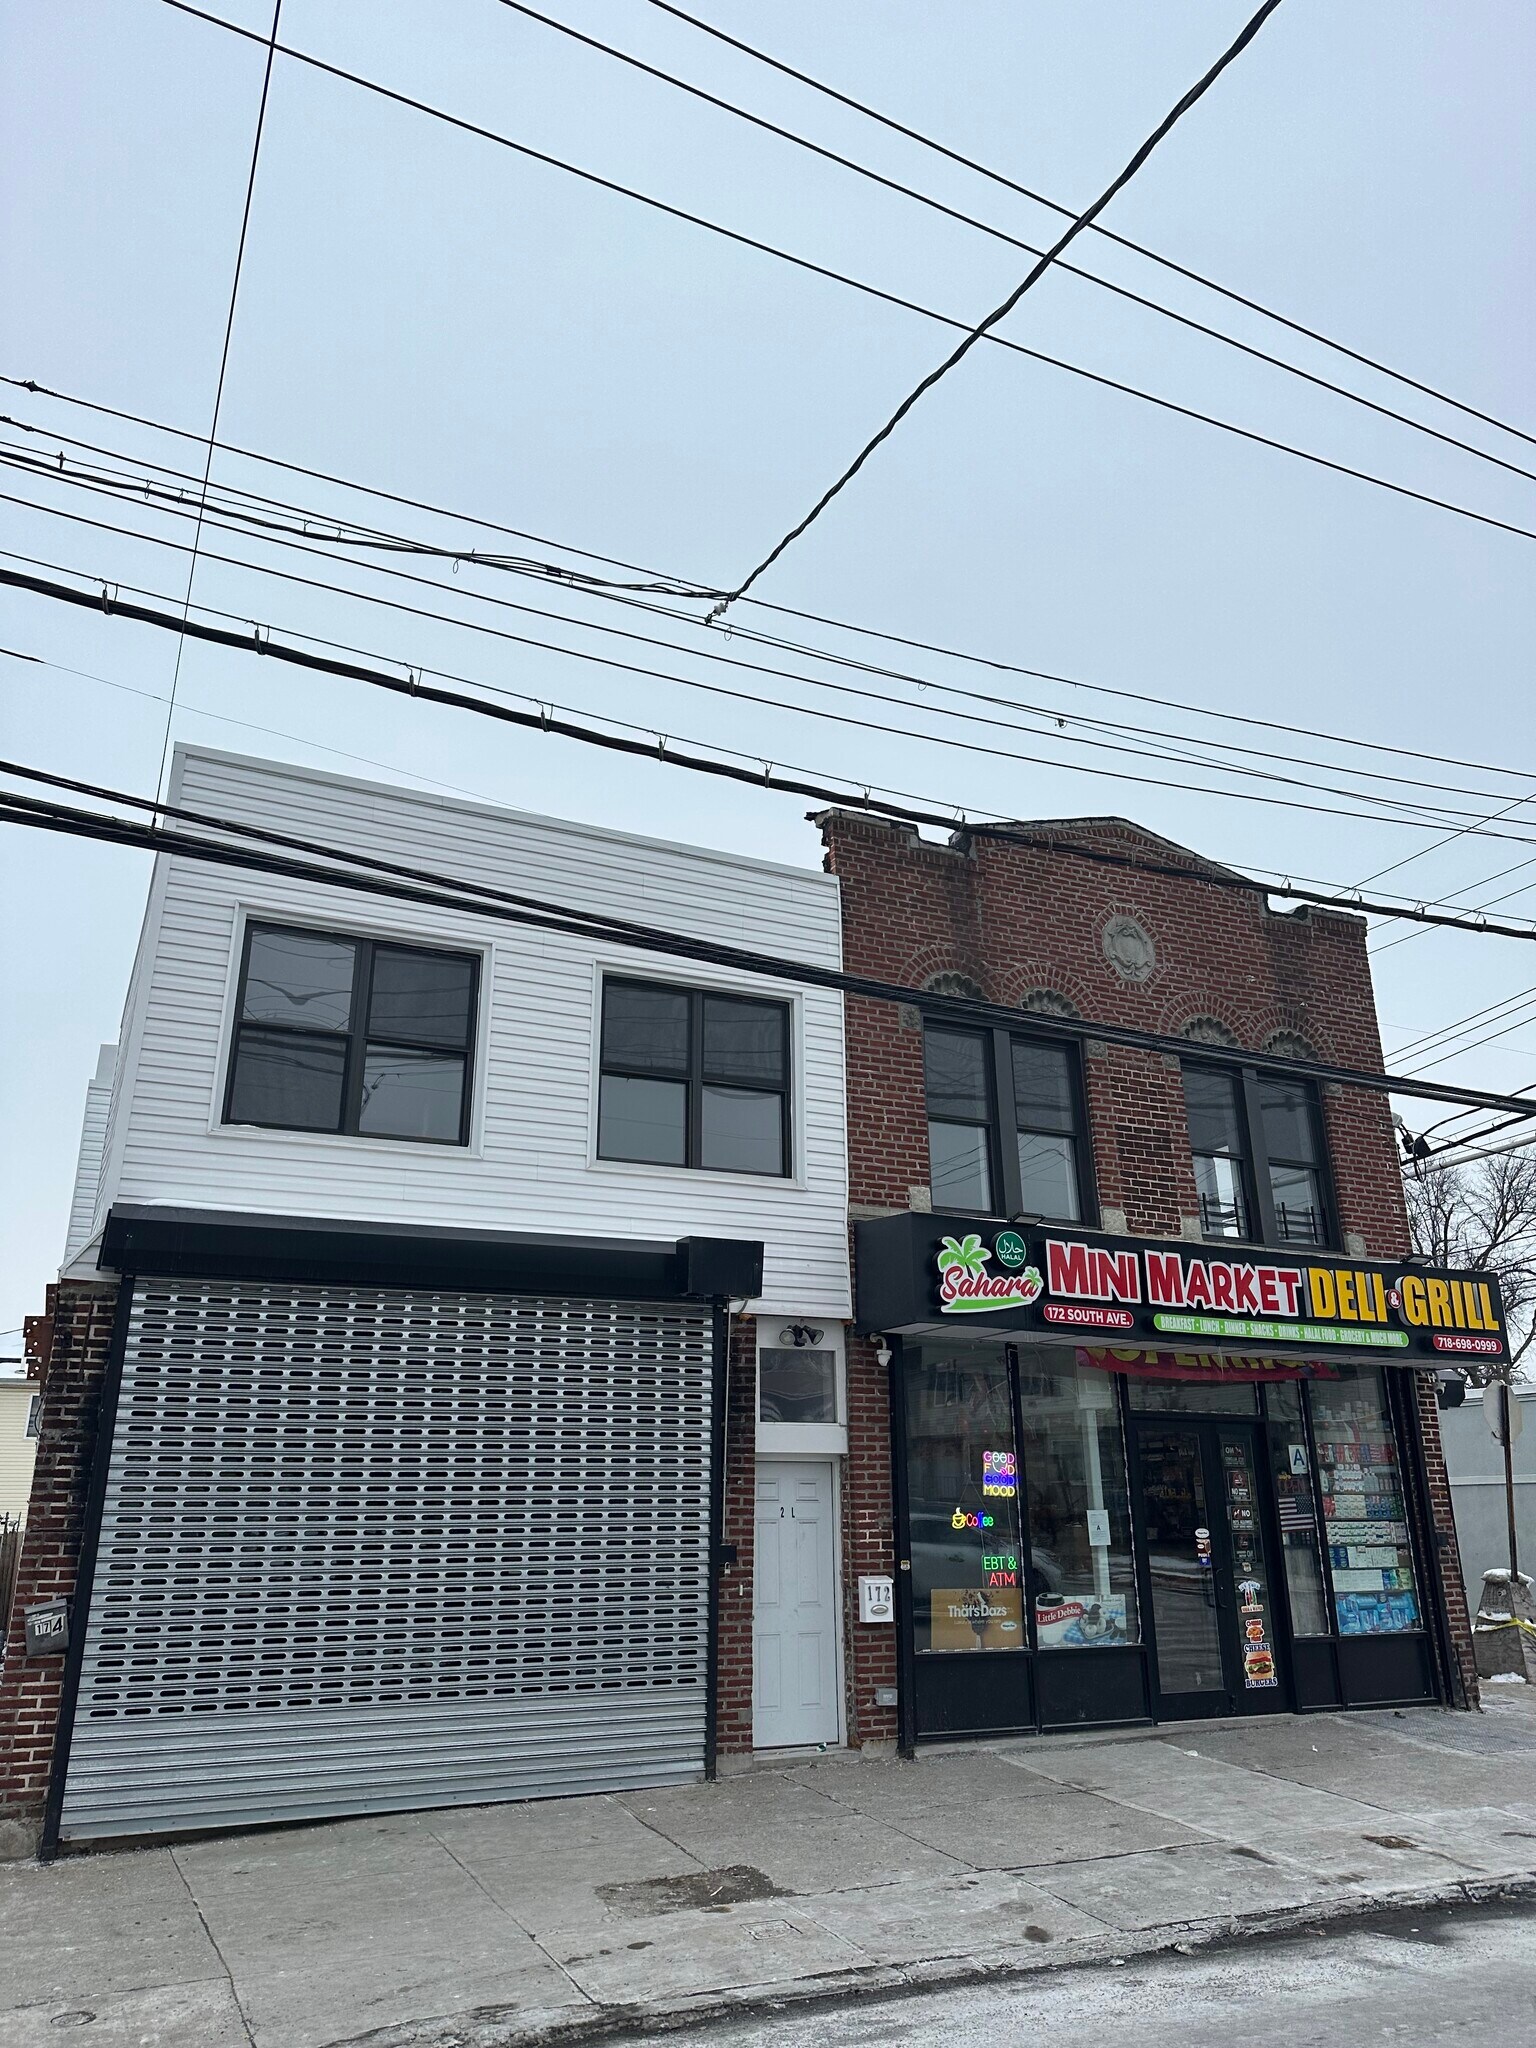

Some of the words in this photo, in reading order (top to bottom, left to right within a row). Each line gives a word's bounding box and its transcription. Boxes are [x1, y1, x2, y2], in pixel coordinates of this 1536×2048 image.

[1001, 1253, 1022, 1261] HALAL
[942, 1266, 1038, 1300] Sahara
[1046, 1240, 1140, 1302] MINI
[1145, 1250, 1301, 1316] MARKET
[1308, 1267, 1388, 1323] DELI
[1390, 1292, 1400, 1307] &
[1402, 1275, 1499, 1331] GRILL
[1048, 1307, 1065, 1320] 172
[1067, 1308, 1104, 1323] SOUTH
[1107, 1312, 1130, 1325] AVE.
[1161, 1316, 1195, 1330] BREAKFAST
[1200, 1319, 1220, 1332] LUNCH
[1225, 1321, 1246, 1334] DINNER
[1250, 1323, 1274, 1336] SNACKS
[1279, 1325, 1300, 1338] DRINKS
[1303, 1327, 1321, 1340] HALAL
[1322, 1328, 1336, 1340] FOOD
[1340, 1330, 1365, 1343] GROCERY
[1371, 1332, 1387, 1344] MUCH
[1388, 1333, 1403, 1345] MORE
[1438, 1337, 1497, 1351] 718-698-0999
[983, 1451, 1015, 1463] GOOD
[1293, 1449, 1305, 1466] A
[984, 1474, 1015, 1485] GOOD
[983, 1485, 1016, 1497] MOOD
[966, 1511, 994, 1528] Coffee
[983, 1556, 1005, 1570] EBT
[1007, 1556, 1018, 1570] &
[989, 1572, 1016, 1587] ATM
[868, 1586, 891, 1601] 172
[1037, 1612, 1057, 1622] Little
[1057, 1606, 1081, 1619] Debbie
[37, 1616, 62, 1634] 174
[1244, 1644, 1270, 1652] CHEESE
[1246, 1679, 1277, 1688] BURGERS
